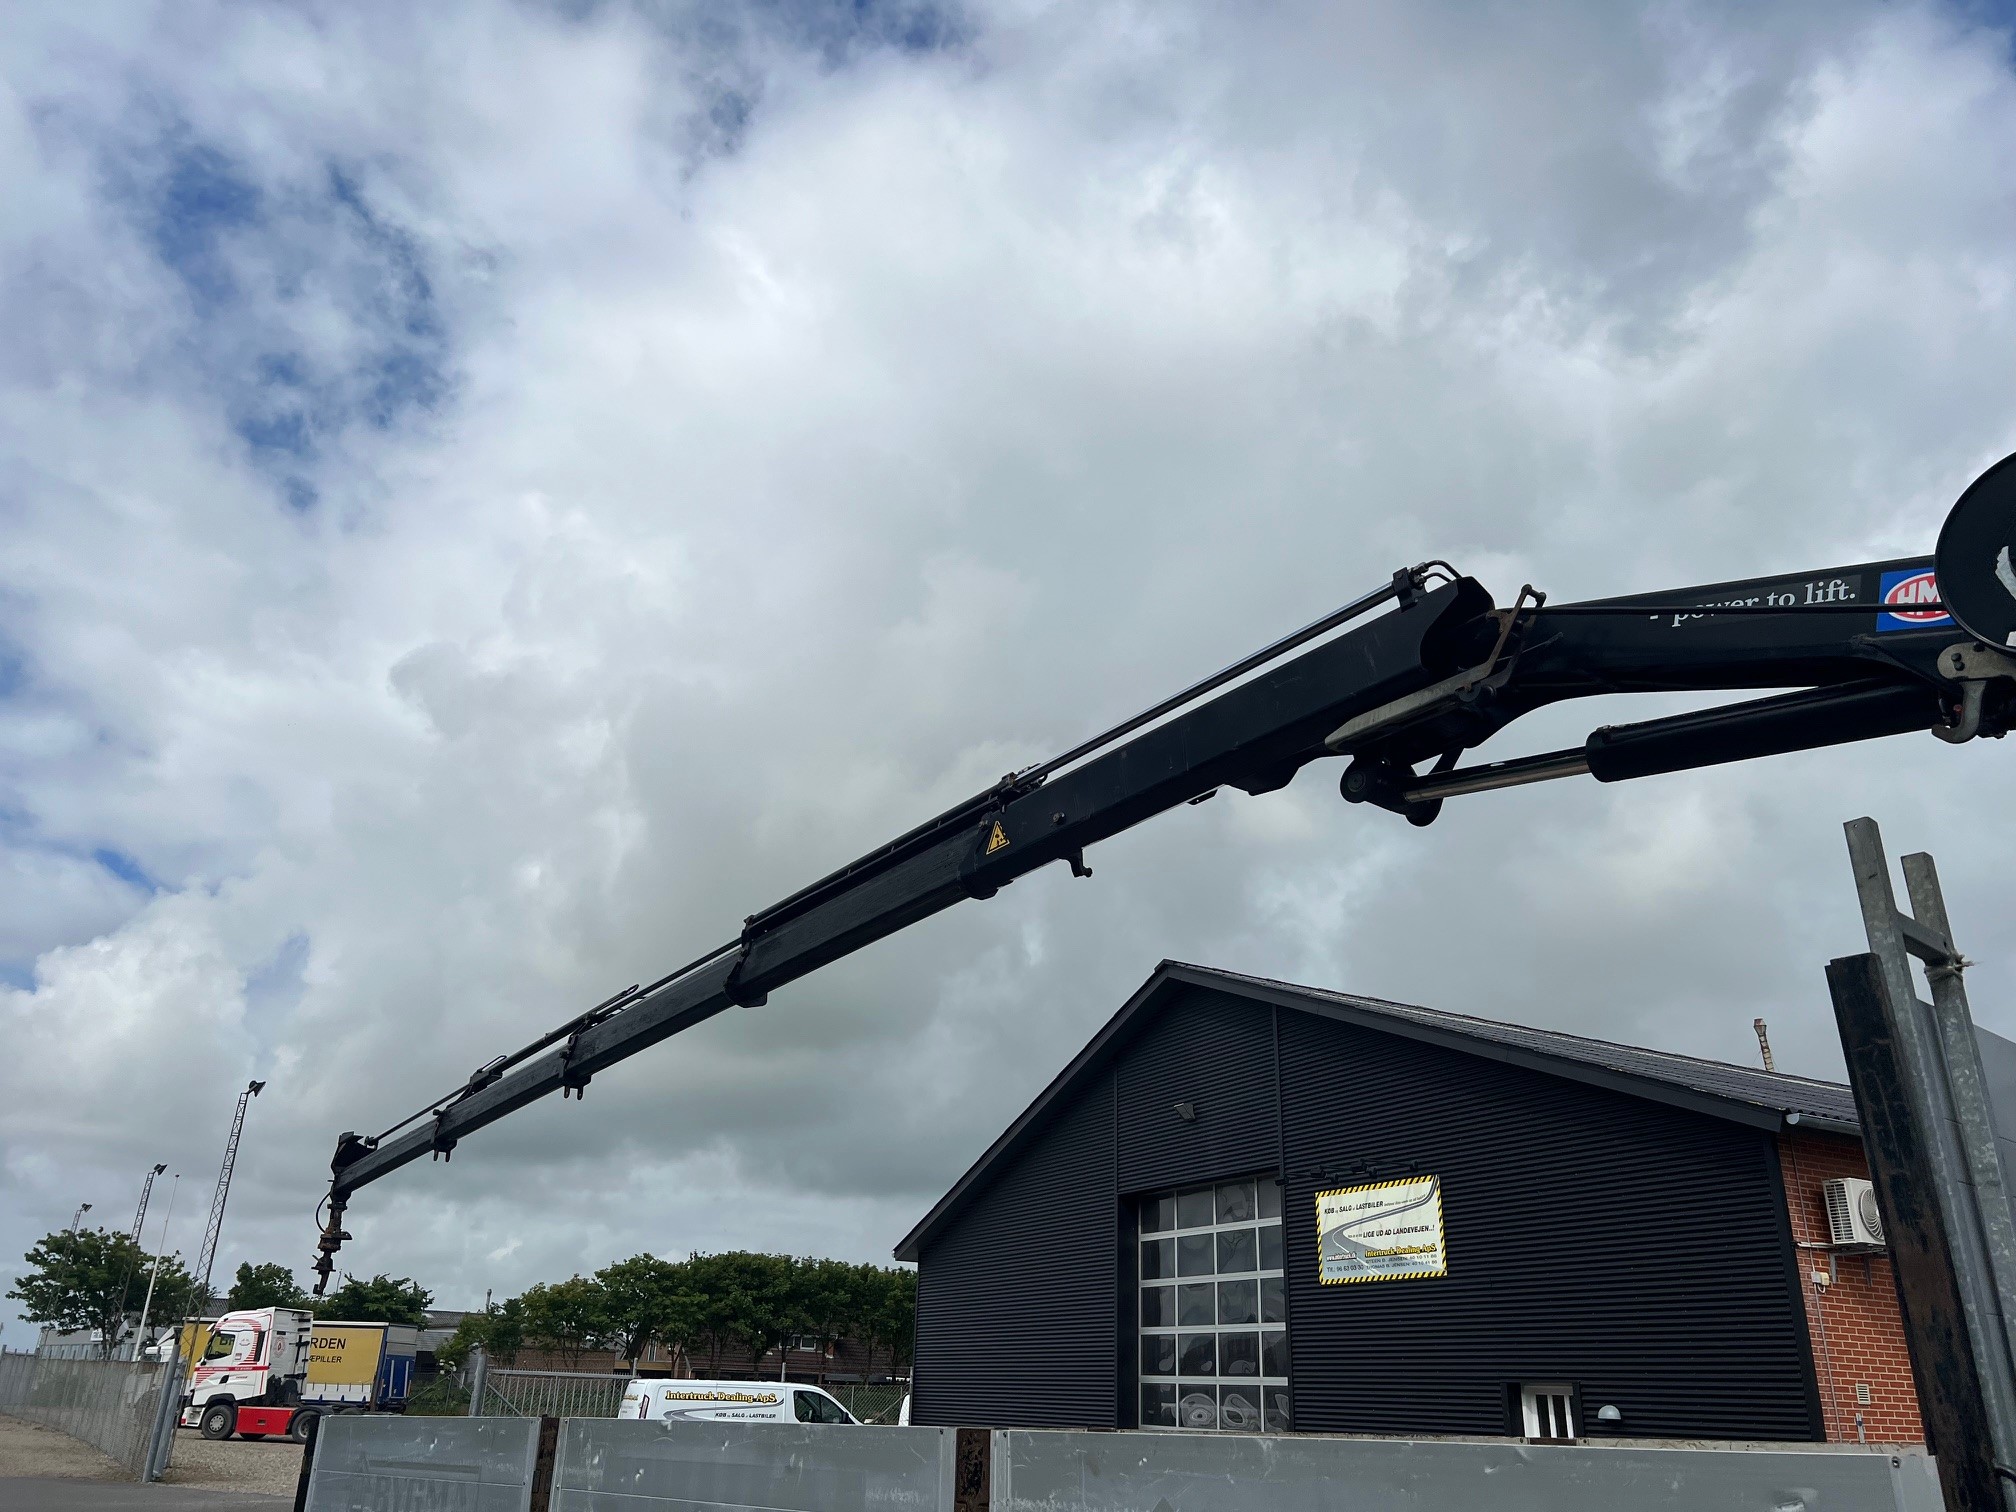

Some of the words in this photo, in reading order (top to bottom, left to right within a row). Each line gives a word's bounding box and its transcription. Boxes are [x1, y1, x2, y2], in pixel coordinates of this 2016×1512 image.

[1766, 592, 1795, 607] to
[1803, 579, 1856, 605] lift.
[1324, 1207, 1335, 1215] KØB
[1339, 1205, 1352, 1213] SALG
[1355, 1201, 1384, 1211] LASTBILER
[1363, 1231, 1375, 1239] LIGE
[666, 1390, 715, 1401] Intertruck
[717, 1391, 754, 1403] Dealing
[754, 1392, 777, 1403] ApS
